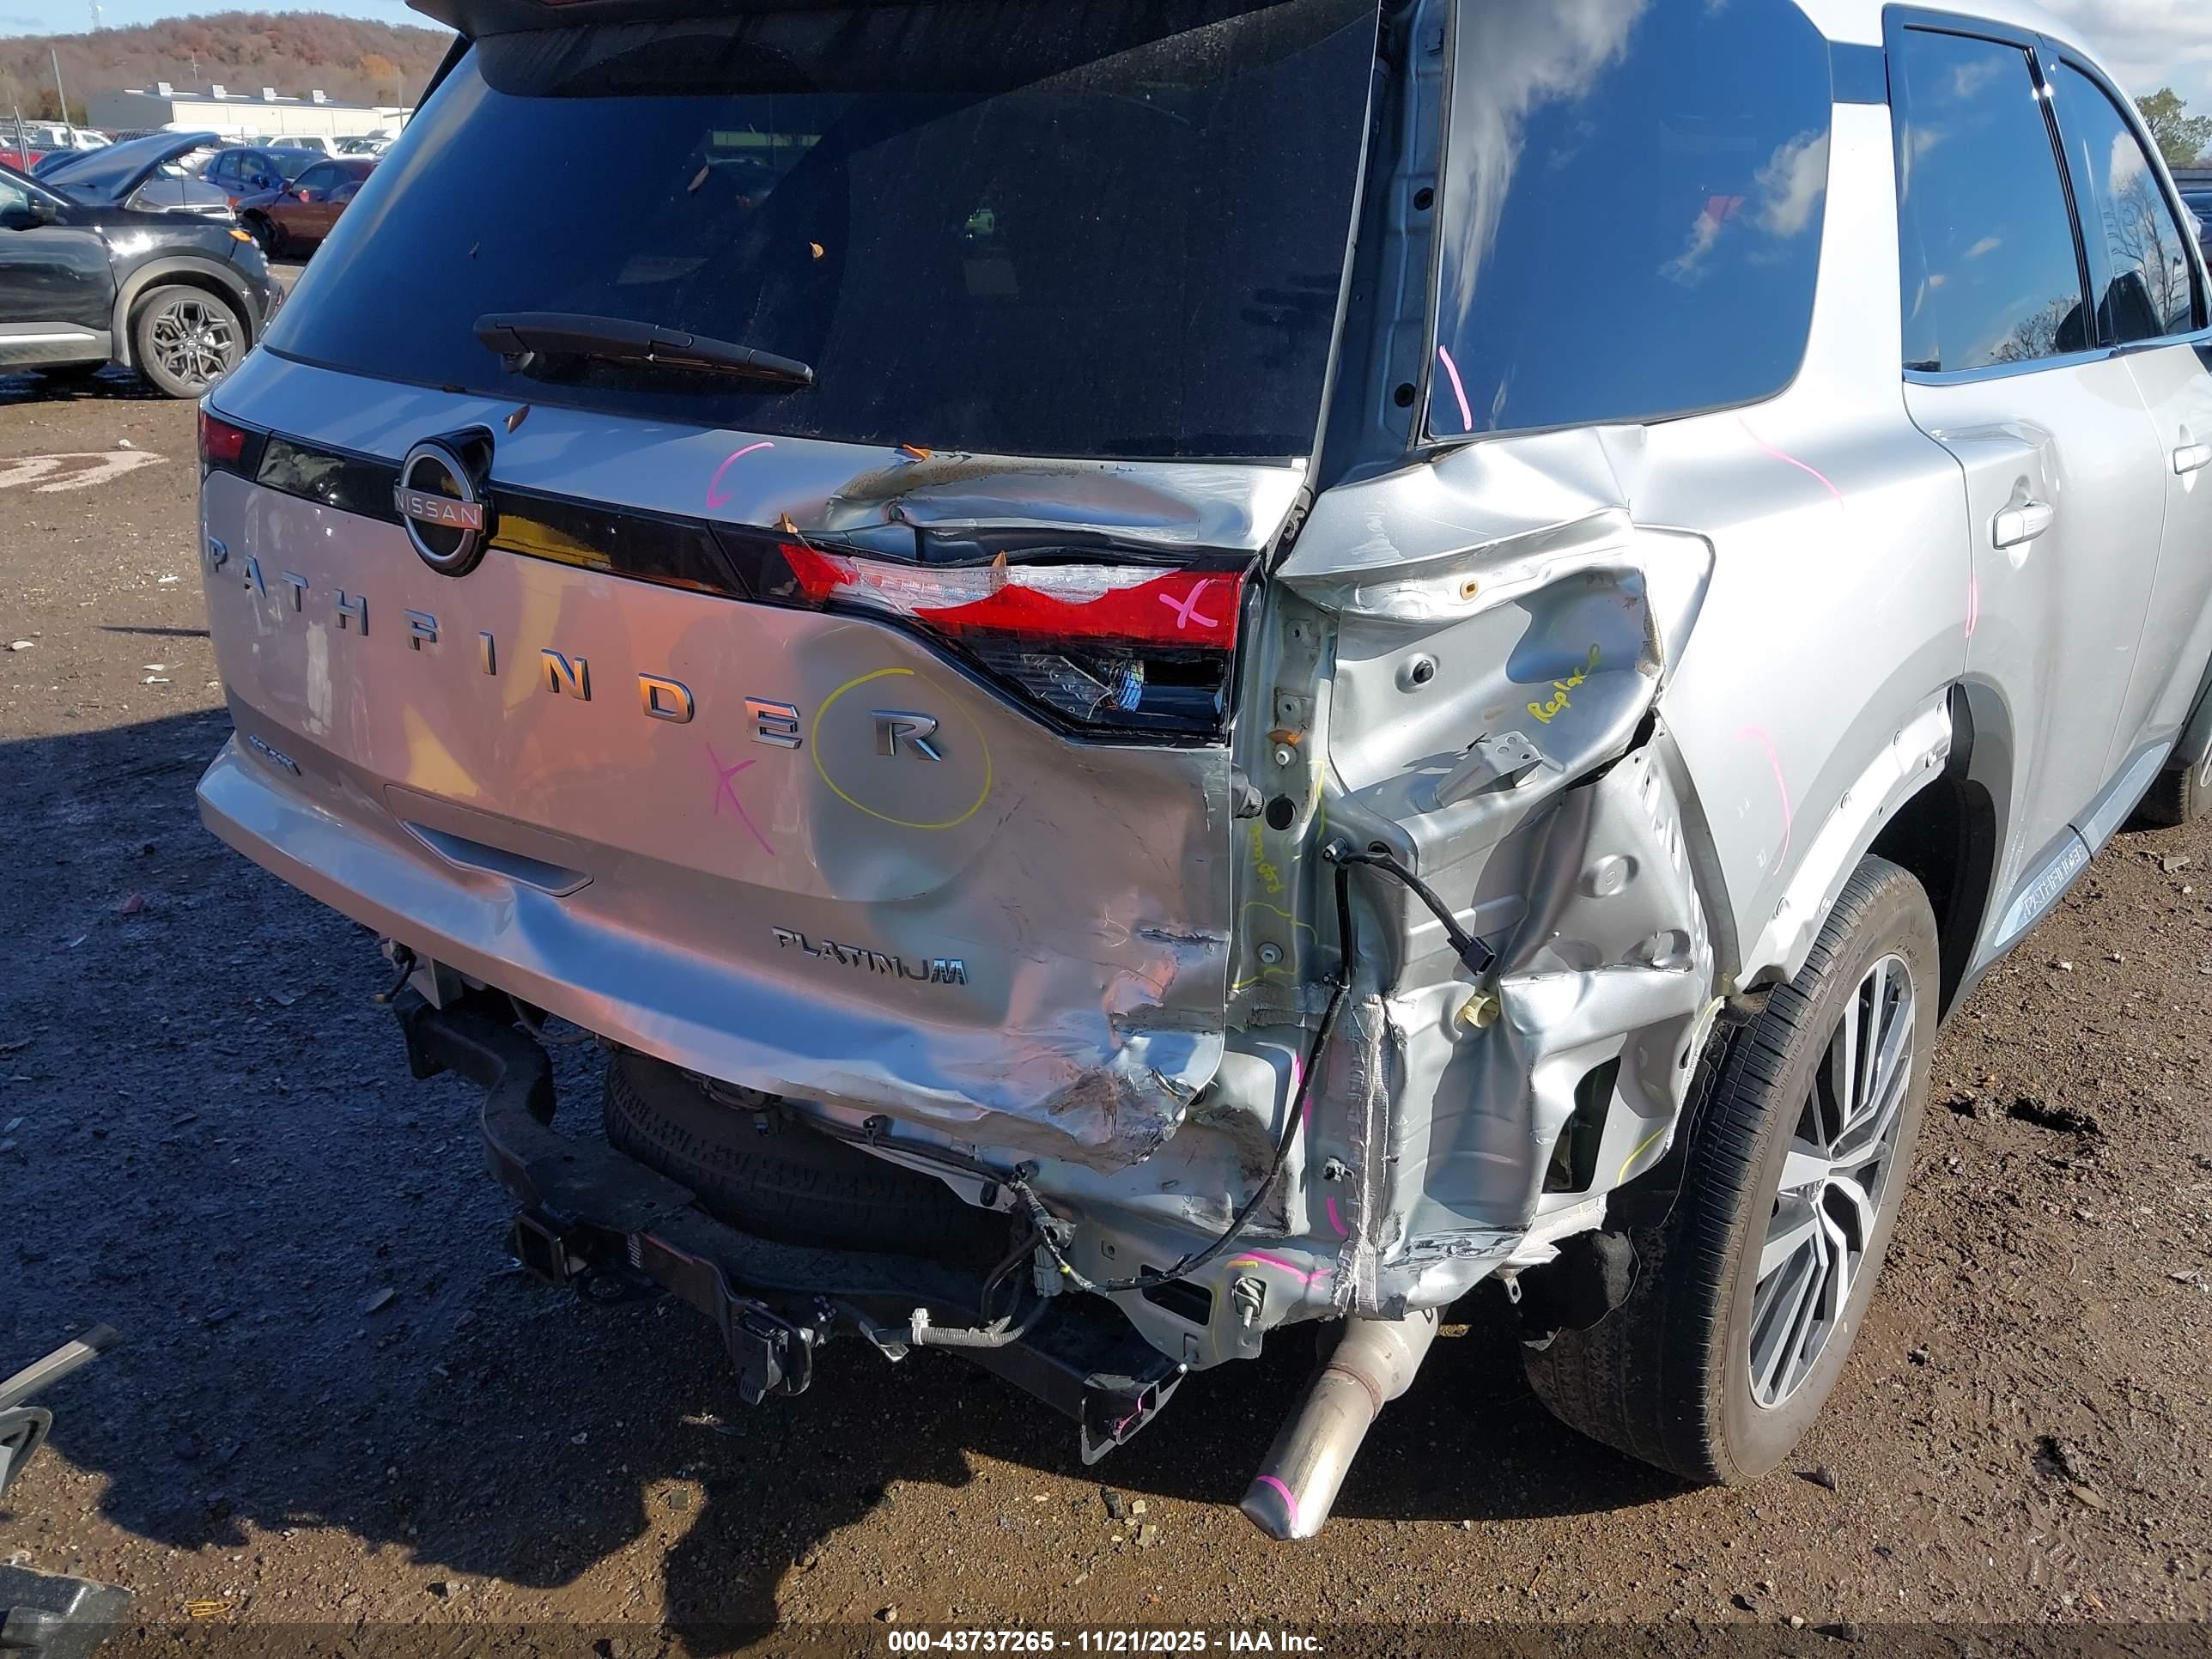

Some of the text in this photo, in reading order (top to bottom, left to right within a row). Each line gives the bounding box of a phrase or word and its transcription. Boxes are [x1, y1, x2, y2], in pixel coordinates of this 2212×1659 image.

[395, 489, 478, 526] NISSAN
[207, 535, 942, 763] PATHFINDER
[771, 926, 968, 986] PLATINUM
